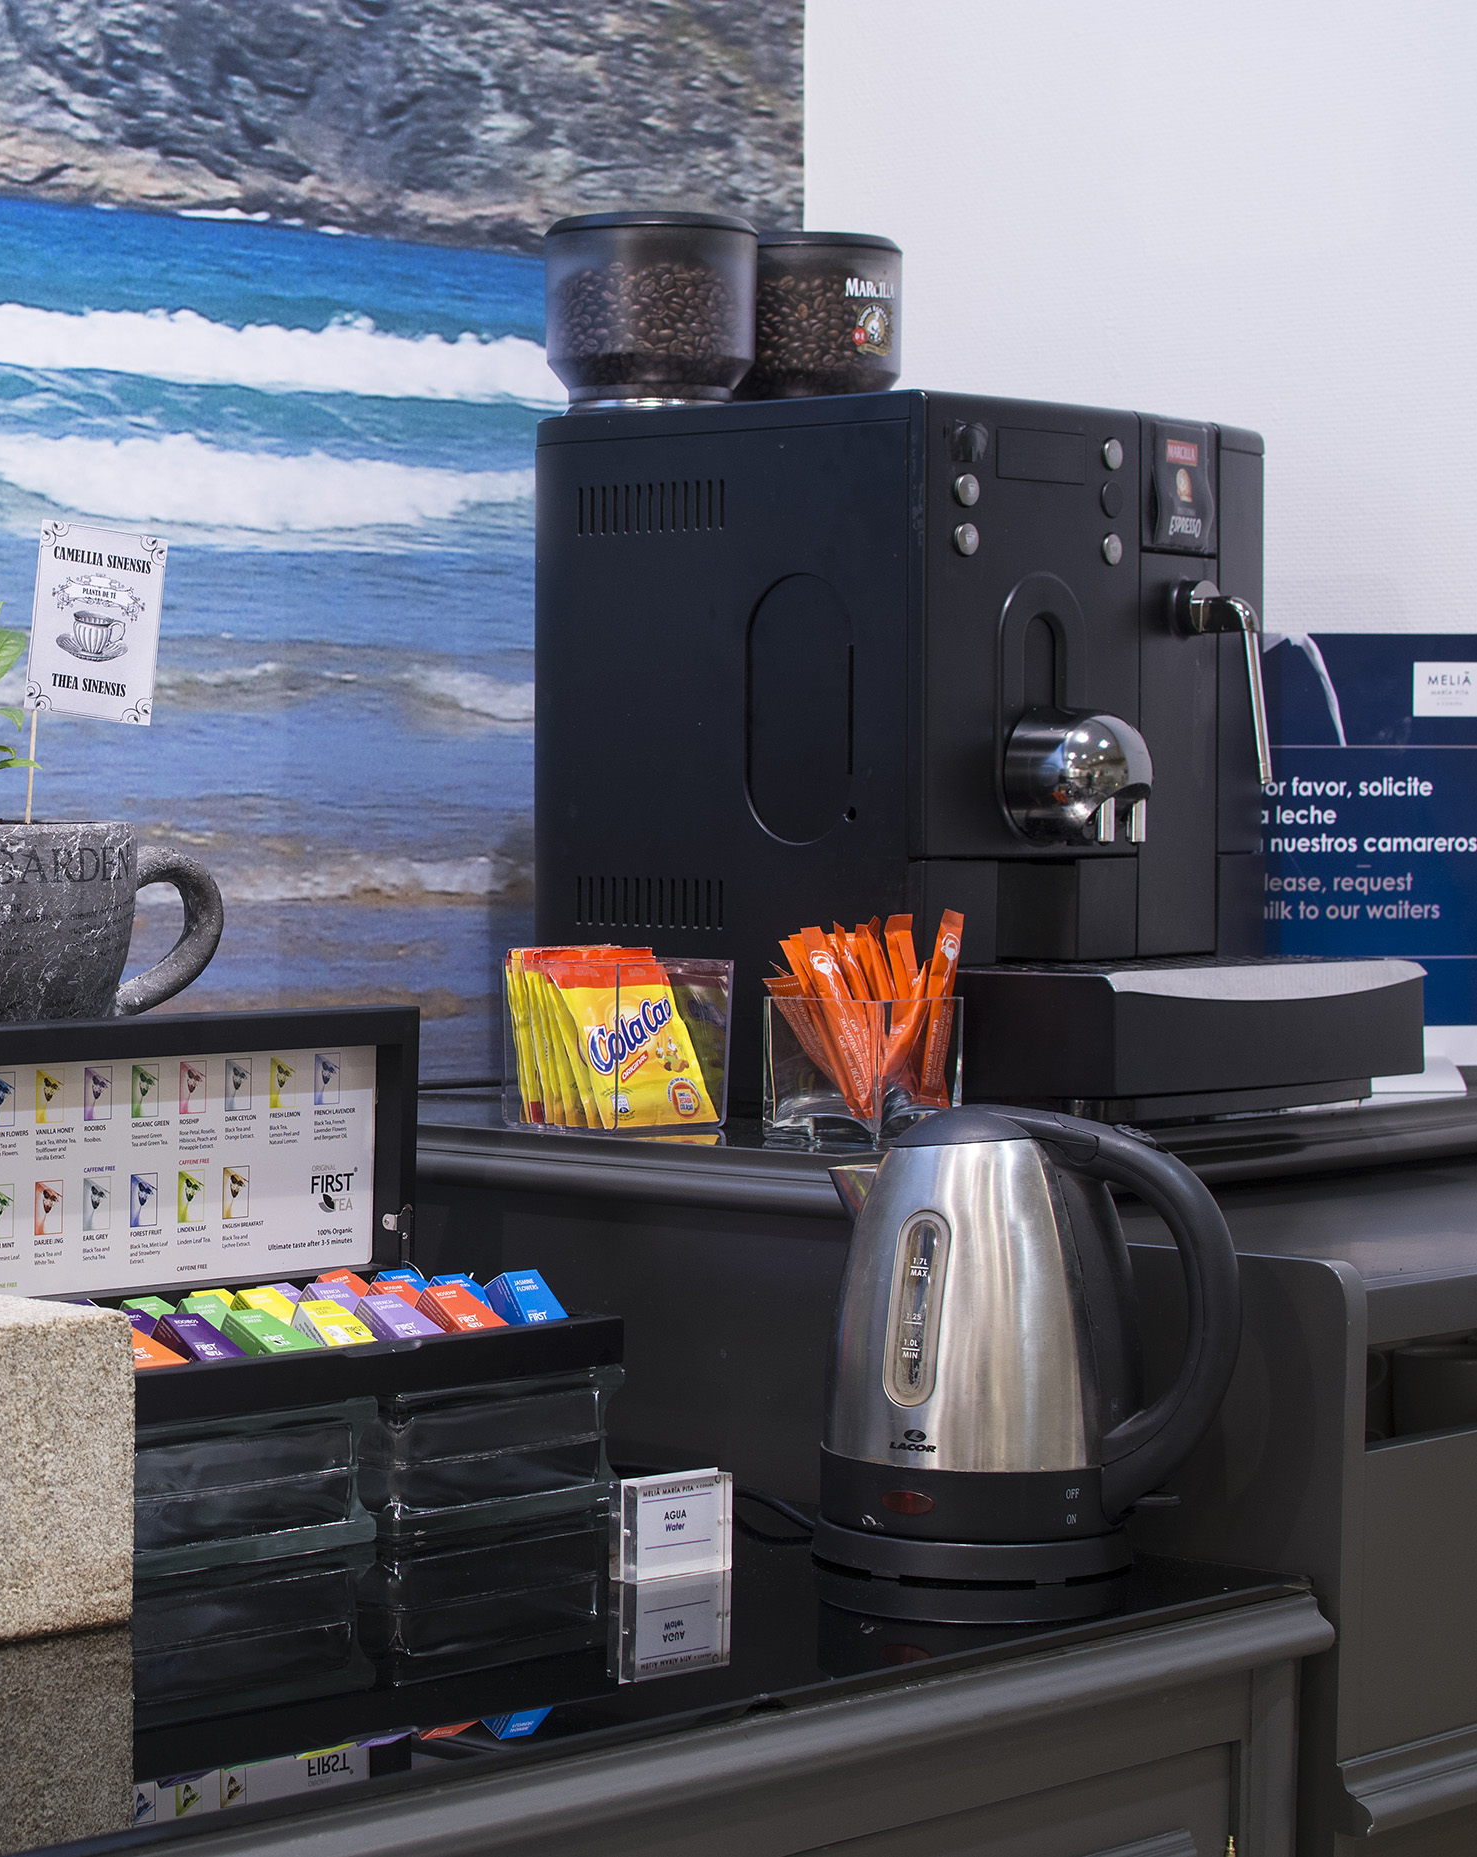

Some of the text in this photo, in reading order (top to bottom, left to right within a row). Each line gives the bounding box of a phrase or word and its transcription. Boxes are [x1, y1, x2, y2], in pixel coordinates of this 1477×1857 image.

[1168, 515, 1202, 538] ESPRESSO
[54, 546, 151, 574] CAMELLIA SINENSIS
[82, 587, 101, 597] PLANTA
[103, 590, 110, 598] DE
[52, 673, 126, 697] THEA SINENSIS
[1261, 776, 1433, 798] or favor, solicite
[1276, 806, 1337, 824] leche
[1271, 833, 1477, 852] nuestros camareros
[1265, 872, 1412, 896] lease, request
[1264, 900, 1440, 920] ilk to our waiters
[622, 1053, 648, 1080] ORIGINAL
[311, 1173, 354, 1194] FIRST
[333, 1198, 353, 1211] TEA
[332, 1227, 353, 1235] Organic
[34, 1238, 63, 1246] DARJEEING
[268, 1243, 291, 1251] Ultimate
[910, 1269, 928, 1277] MAX
[516, 1284, 539, 1292] FLOWERS
[527, 1310, 548, 1322] FIRST
[902, 1351, 918, 1359] MIN
[889, 1441, 937, 1453] LACOR
[1065, 1488, 1080, 1499] OFF
[664, 1509, 687, 1520] AGUA
[1066, 1514, 1077, 1525] ON
[666, 1522, 685, 1532] Water
